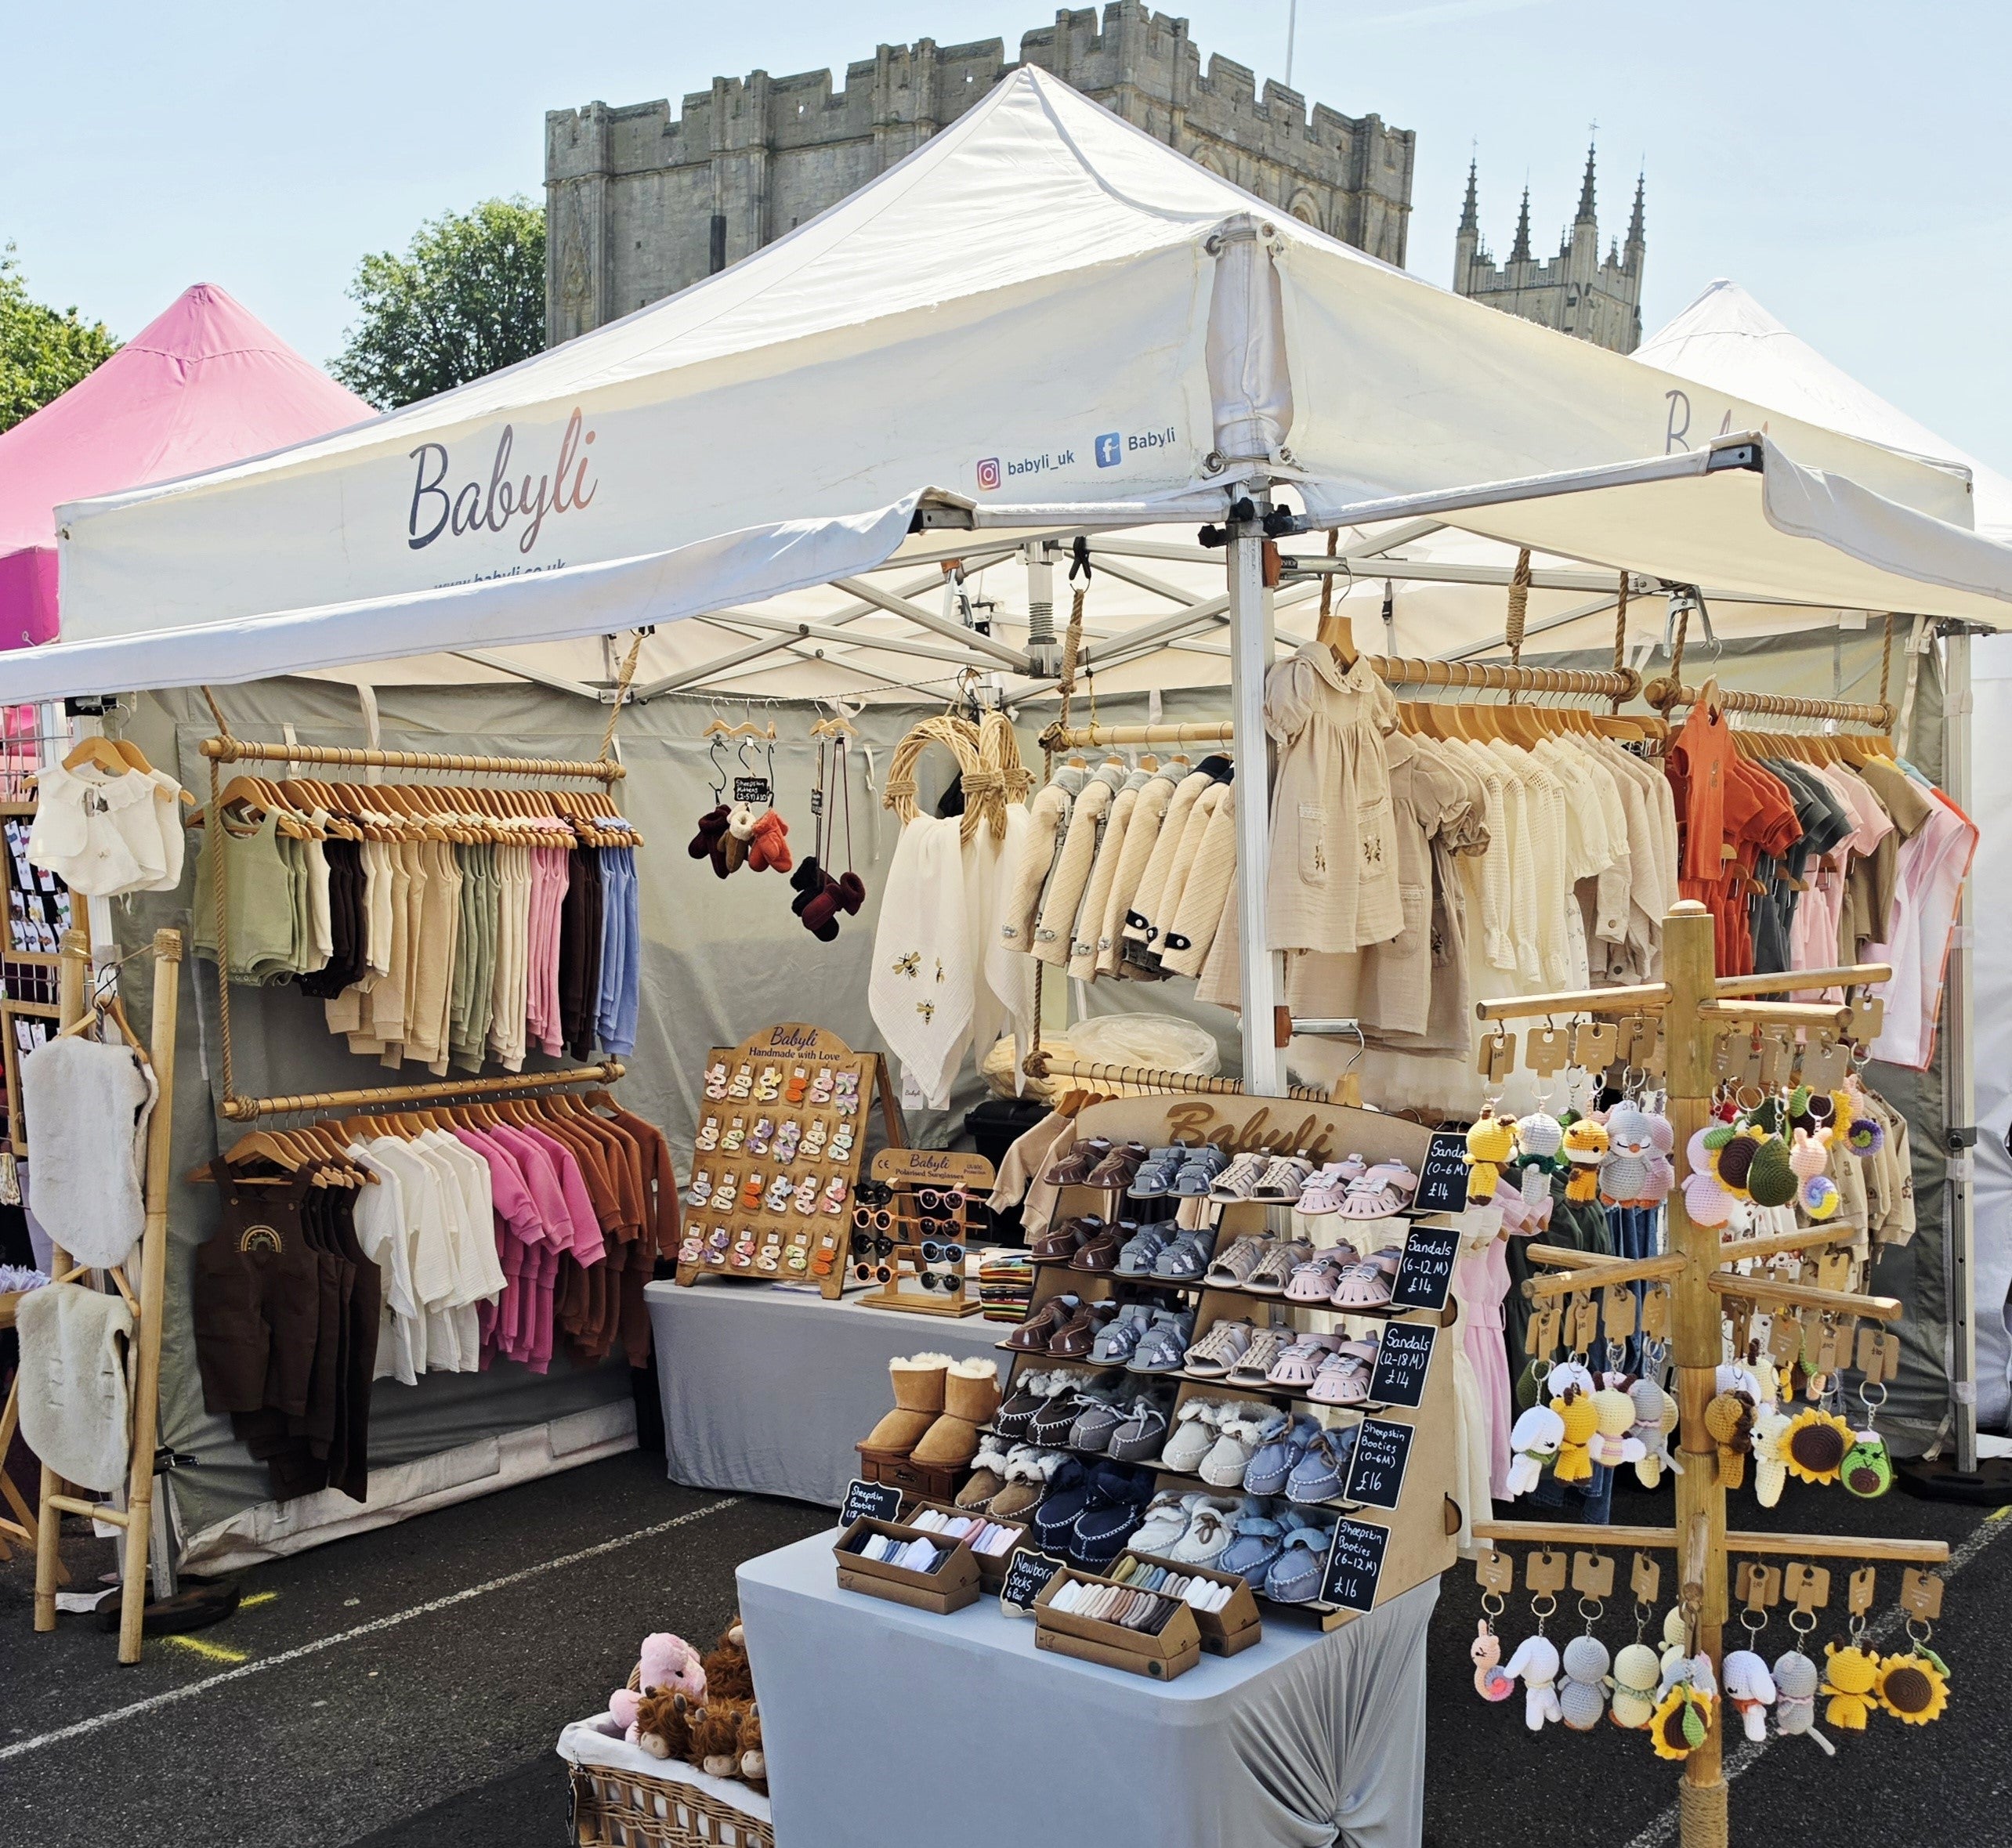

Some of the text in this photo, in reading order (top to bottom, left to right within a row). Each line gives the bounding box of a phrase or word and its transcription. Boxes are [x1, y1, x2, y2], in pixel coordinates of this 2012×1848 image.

[1128, 427, 1175, 450] Babyli
[1008, 450, 1075, 476] babyli_uk
[408, 406, 598, 553] Babyli
[769, 1026, 818, 1051] Babyli
[748, 1047, 840, 1061] Handmade with Love
[1167, 1101, 1334, 1161] Babyli
[910, 1153, 950, 1172] Babyli
[928, 1170, 964, 1180] Sunglasses
[1428, 1182, 1449, 1200] £14
[1408, 1233, 1453, 1256] Sandals
[1407, 1277, 1432, 1294] £14
[1386, 1328, 1431, 1351] Sandals
[1384, 1369, 1409, 1389] £14
[1364, 1423, 1405, 1441] Sheepskin
[1362, 1435, 1397, 1454] Booties
[1355, 1471, 1382, 1491] £16
[851, 1485, 884, 1502] Sheepskin
[1341, 1521, 1382, 1545] Sheepskin
[1338, 1535, 1371, 1557] Booties
[1014, 1553, 1054, 1580] Newborn
[1009, 1571, 1033, 1592] Socks
[1334, 1576, 1358, 1597] £16
[1007, 1586, 1012, 1597] 6
[1012, 1587, 1025, 1601] Pair
